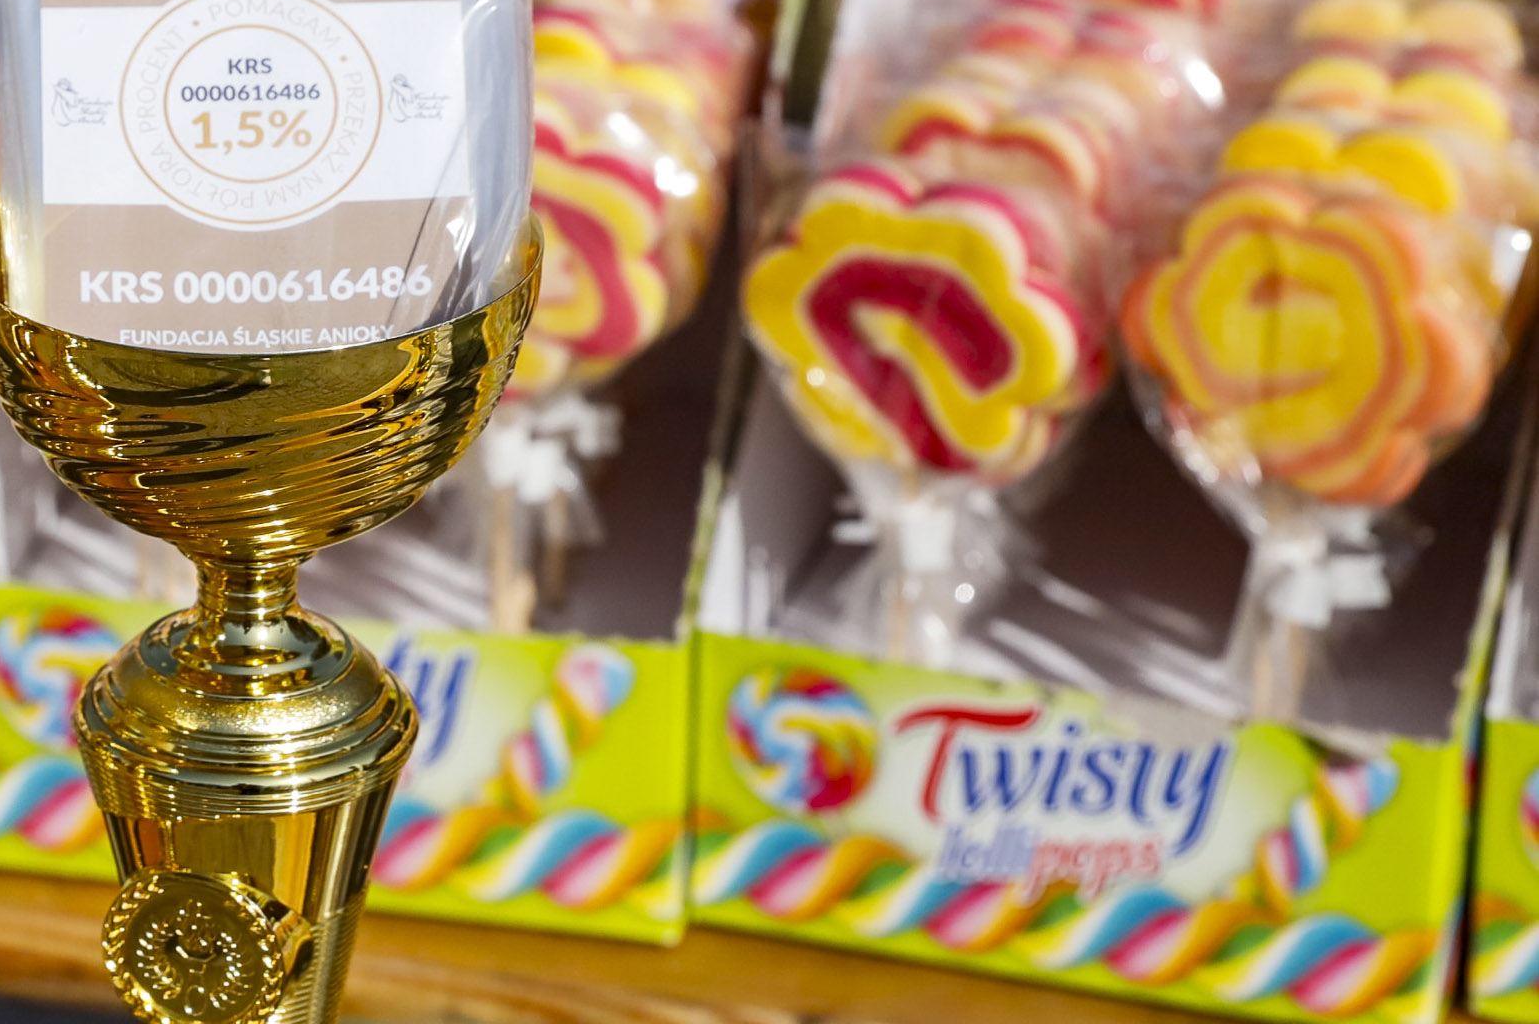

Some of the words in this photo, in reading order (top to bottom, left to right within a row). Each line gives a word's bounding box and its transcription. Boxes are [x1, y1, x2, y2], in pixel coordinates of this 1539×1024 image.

[227, 57, 273, 75] KRS
[181, 83, 321, 102] 0000616486
[191, 109, 312, 155] 1,5%
[80, 270, 163, 304] KRS
[174, 264, 433, 304] 0000616486
[119, 328, 229, 346] FUNDACJA
[233, 326, 312, 348] ŚLĄSKIE
[317, 324, 395, 343] ANIOŁY
